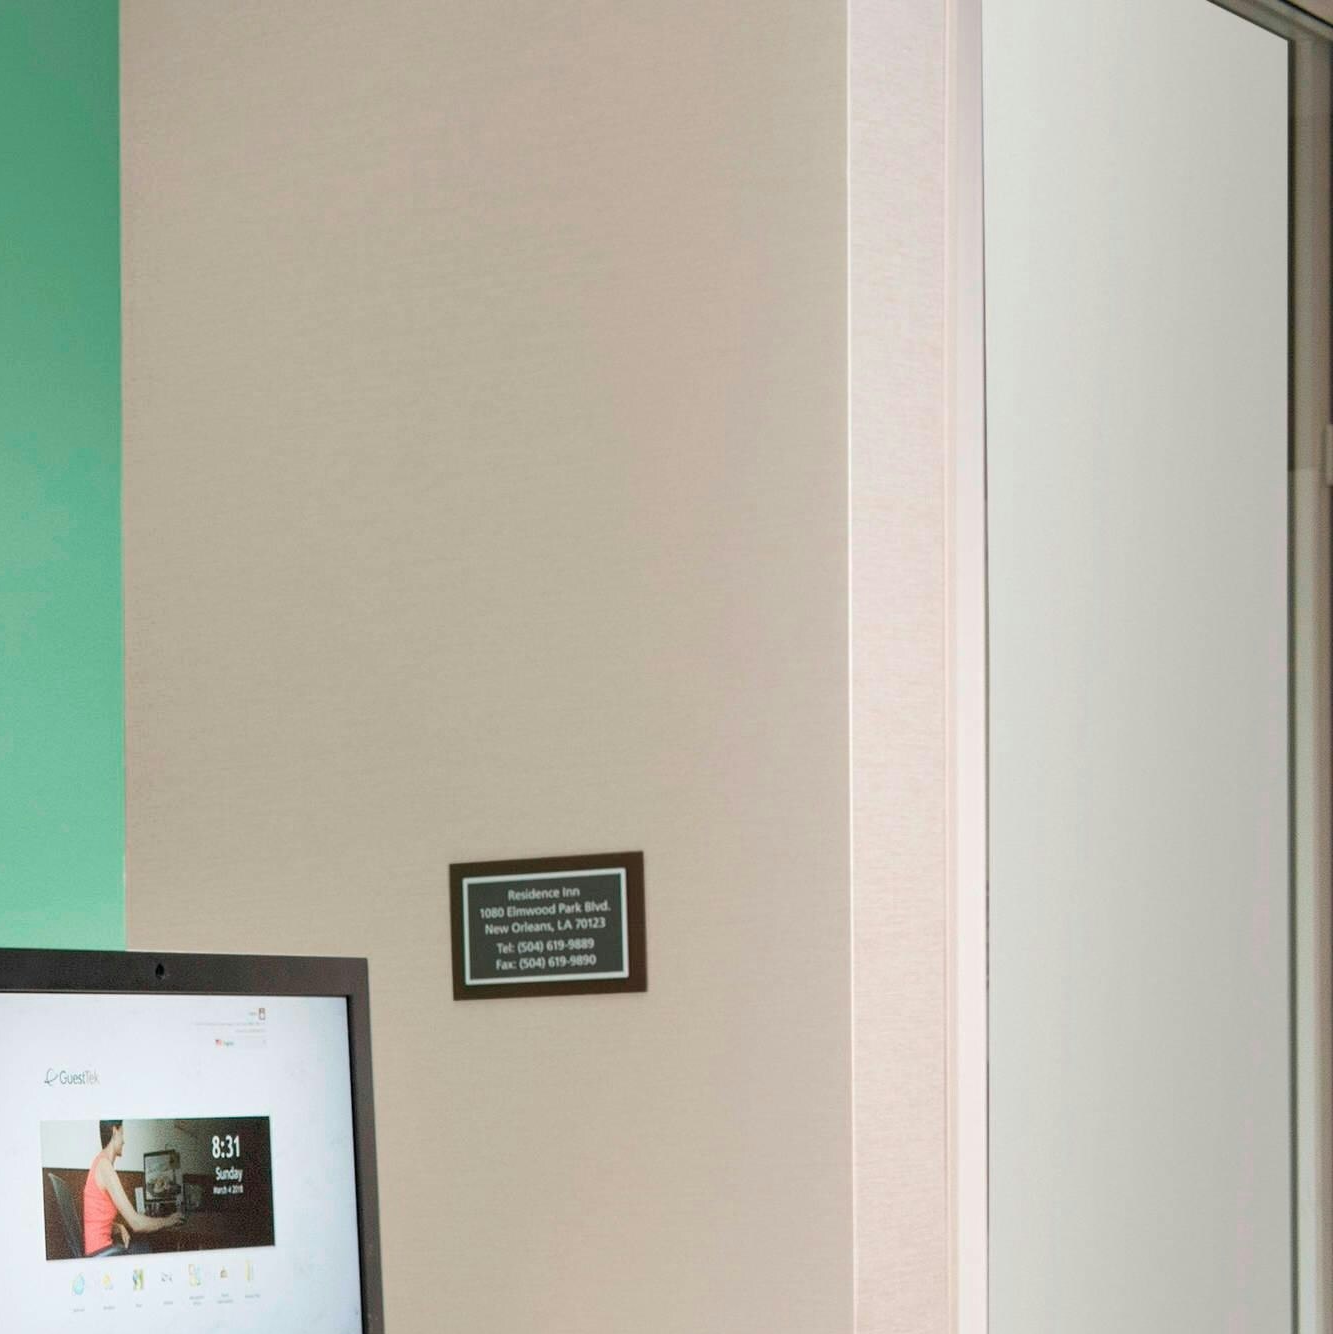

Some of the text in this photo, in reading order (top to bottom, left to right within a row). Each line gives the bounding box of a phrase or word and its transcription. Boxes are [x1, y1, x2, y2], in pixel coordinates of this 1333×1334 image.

[507, 886, 581, 902] Residence Inn
[479, 900, 611, 919] 1080 Elmwood Park Blvd.
[484, 916, 607, 935] New Orleans, LA 70123
[496, 942, 515, 954] Tel:
[517, 940, 545, 954] (504)
[495, 954, 598, 971] Fax: (504) 619-9890
[58, 1069, 101, 1086] GuestTek
[211, 1135, 241, 1158] 8:31
[215, 1166, 244, 1183] Sunday
